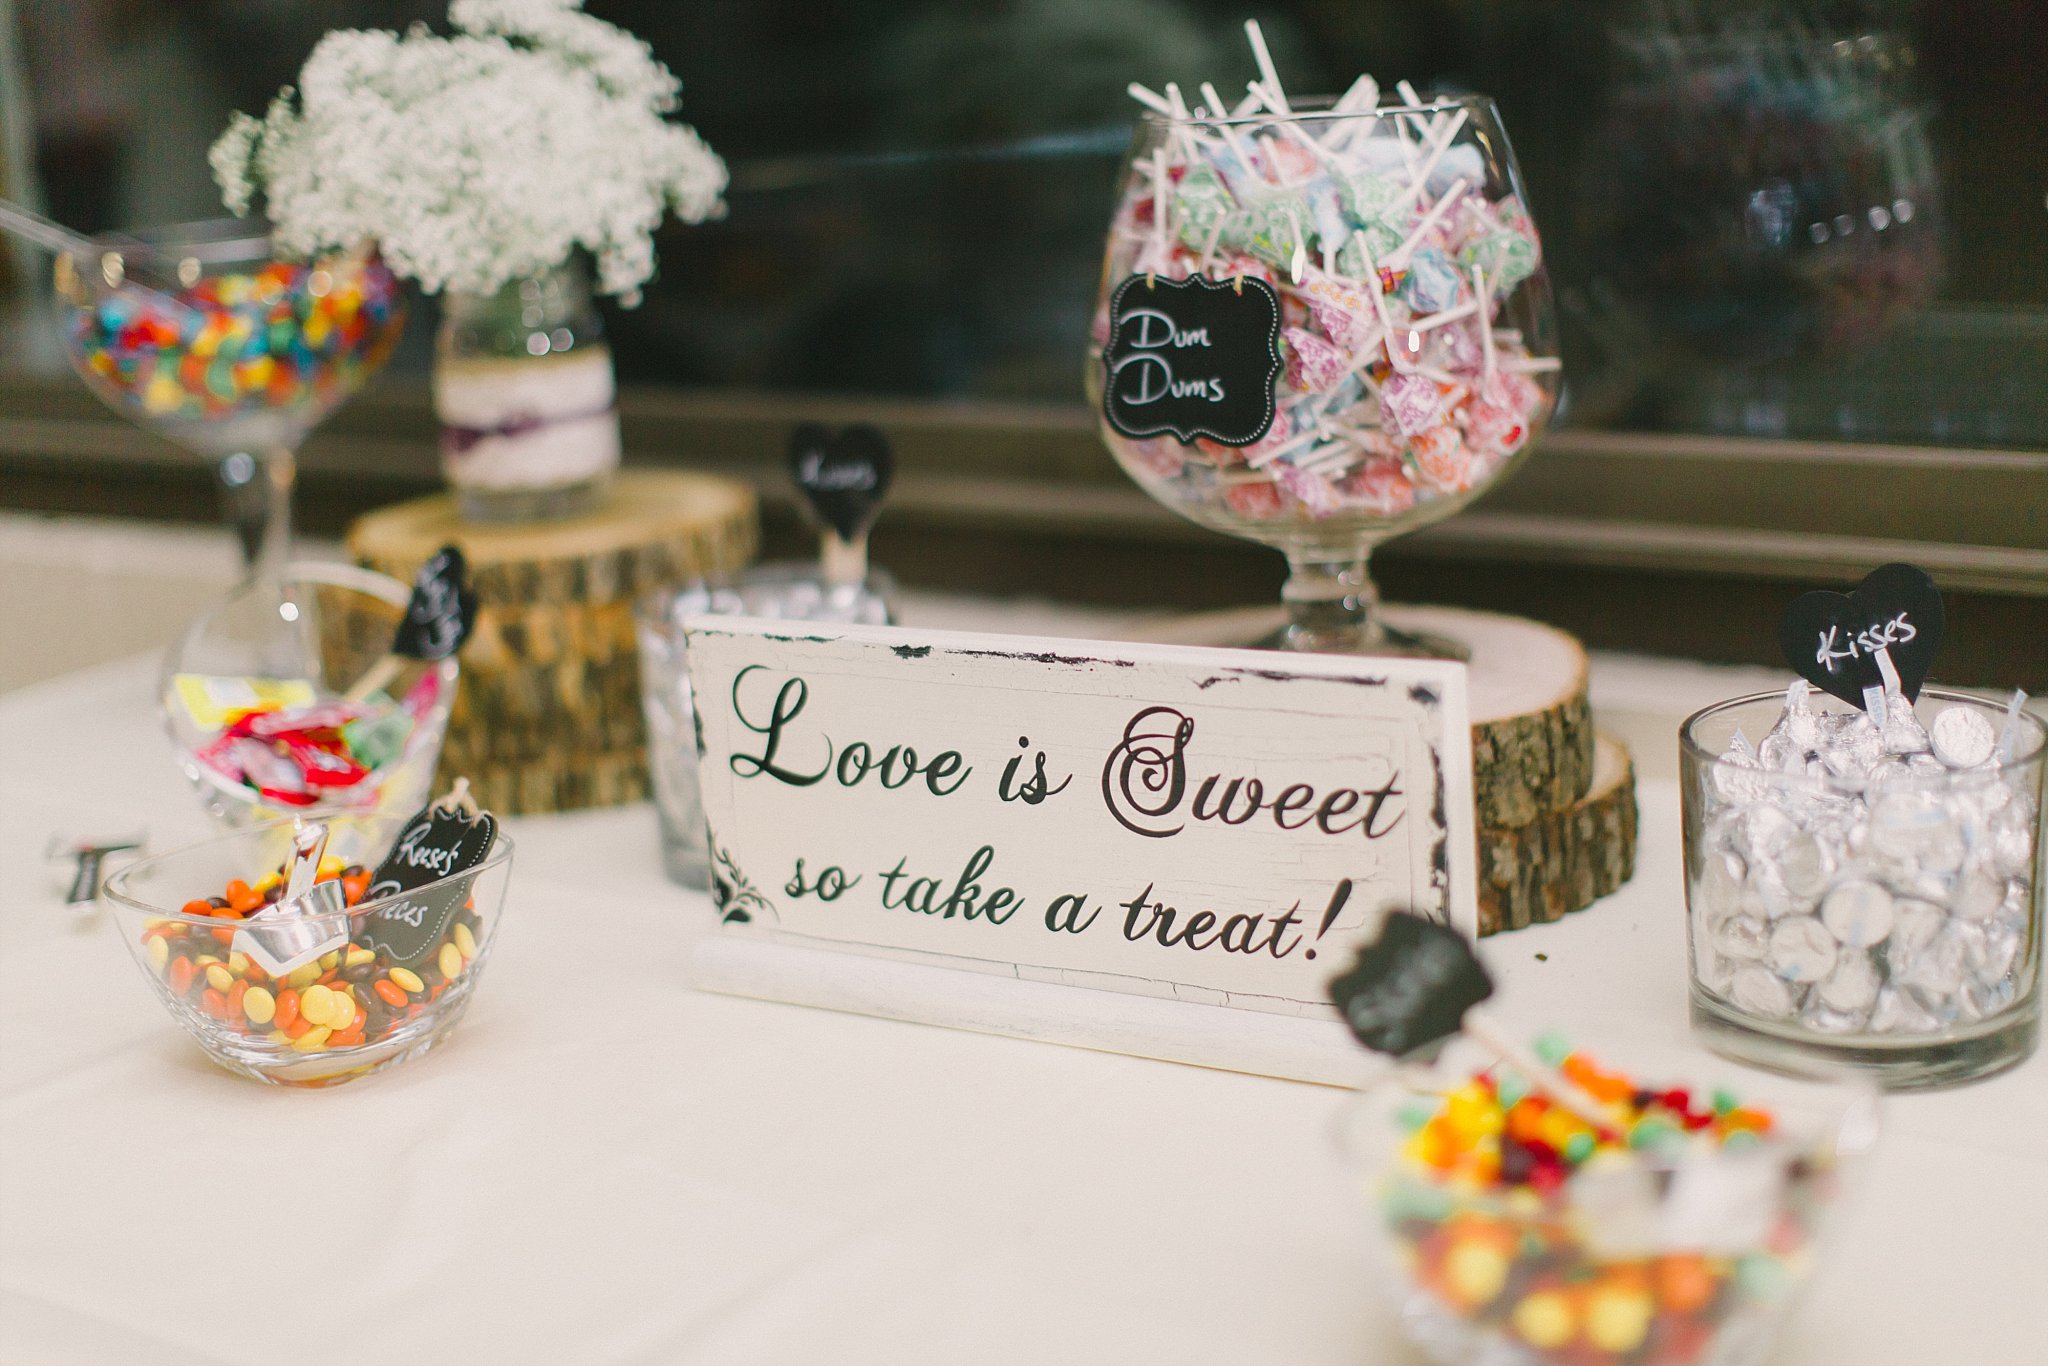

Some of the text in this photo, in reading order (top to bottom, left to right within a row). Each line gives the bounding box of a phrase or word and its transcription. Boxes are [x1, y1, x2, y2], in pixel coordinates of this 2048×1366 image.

[1119, 309, 1212, 348] Dum
[1113, 353, 1225, 405] Dums
[1816, 612, 1917, 672] Kisses
[730, 664, 1406, 839] Love is Sweet
[368, 880, 428, 928] Peces
[785, 845, 1353, 961] so take a treat!
